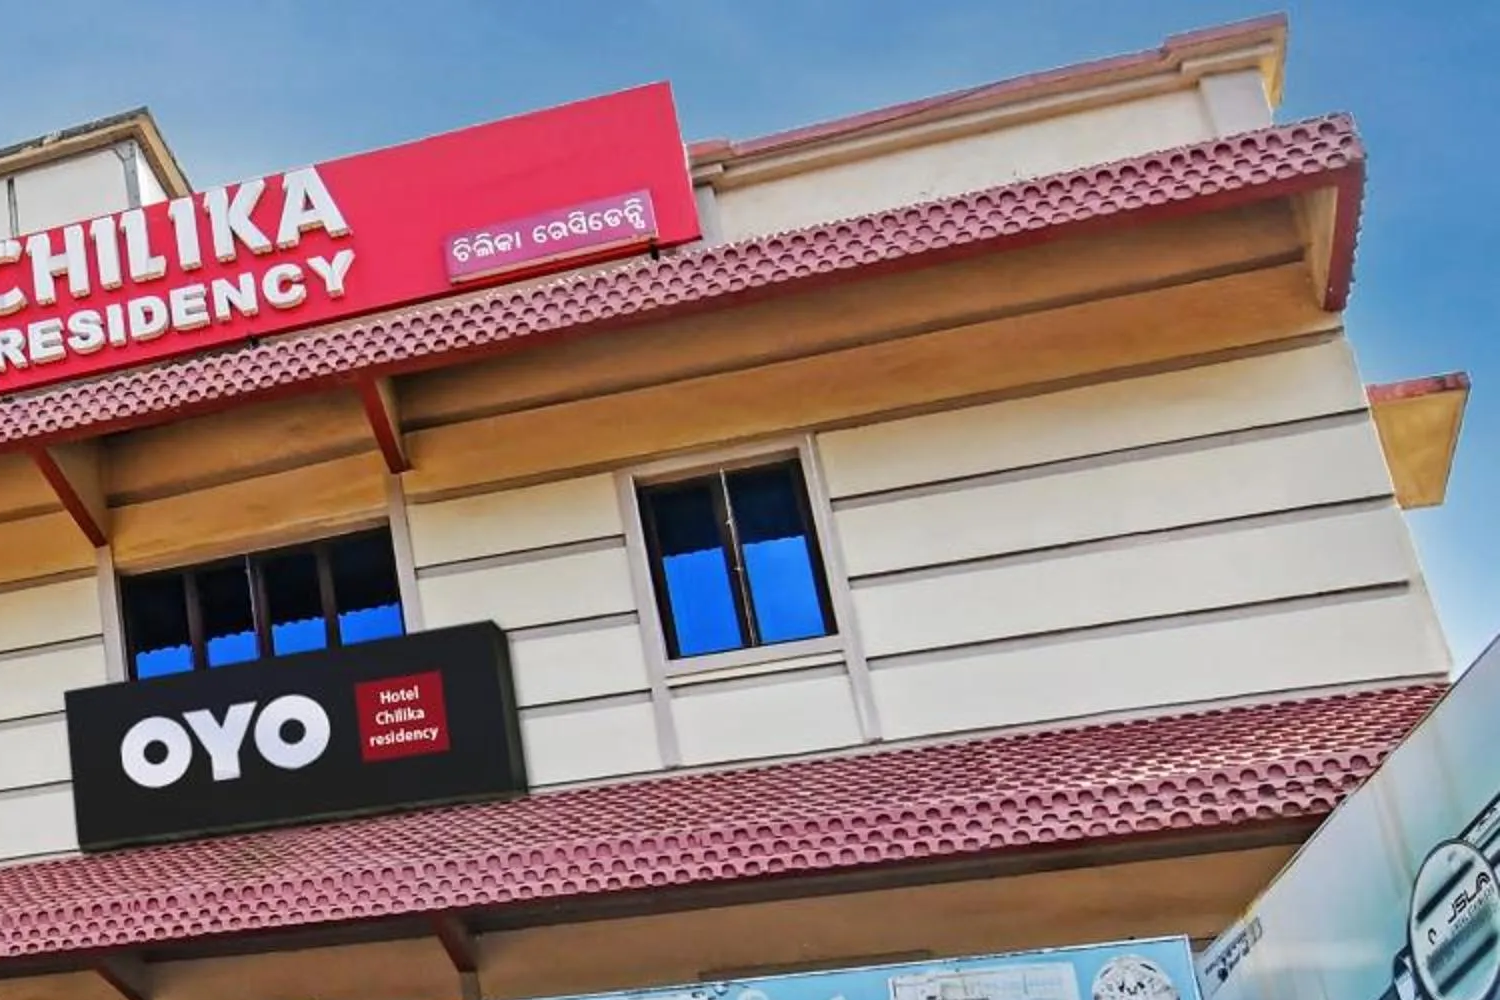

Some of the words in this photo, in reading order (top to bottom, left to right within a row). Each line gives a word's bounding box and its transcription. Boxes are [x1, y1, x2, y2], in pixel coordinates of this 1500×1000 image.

[379, 685, 420, 705] Hotel
[375, 706, 425, 726] Chilika
[121, 694, 331, 788] OYO
[369, 726, 439, 748] residency
